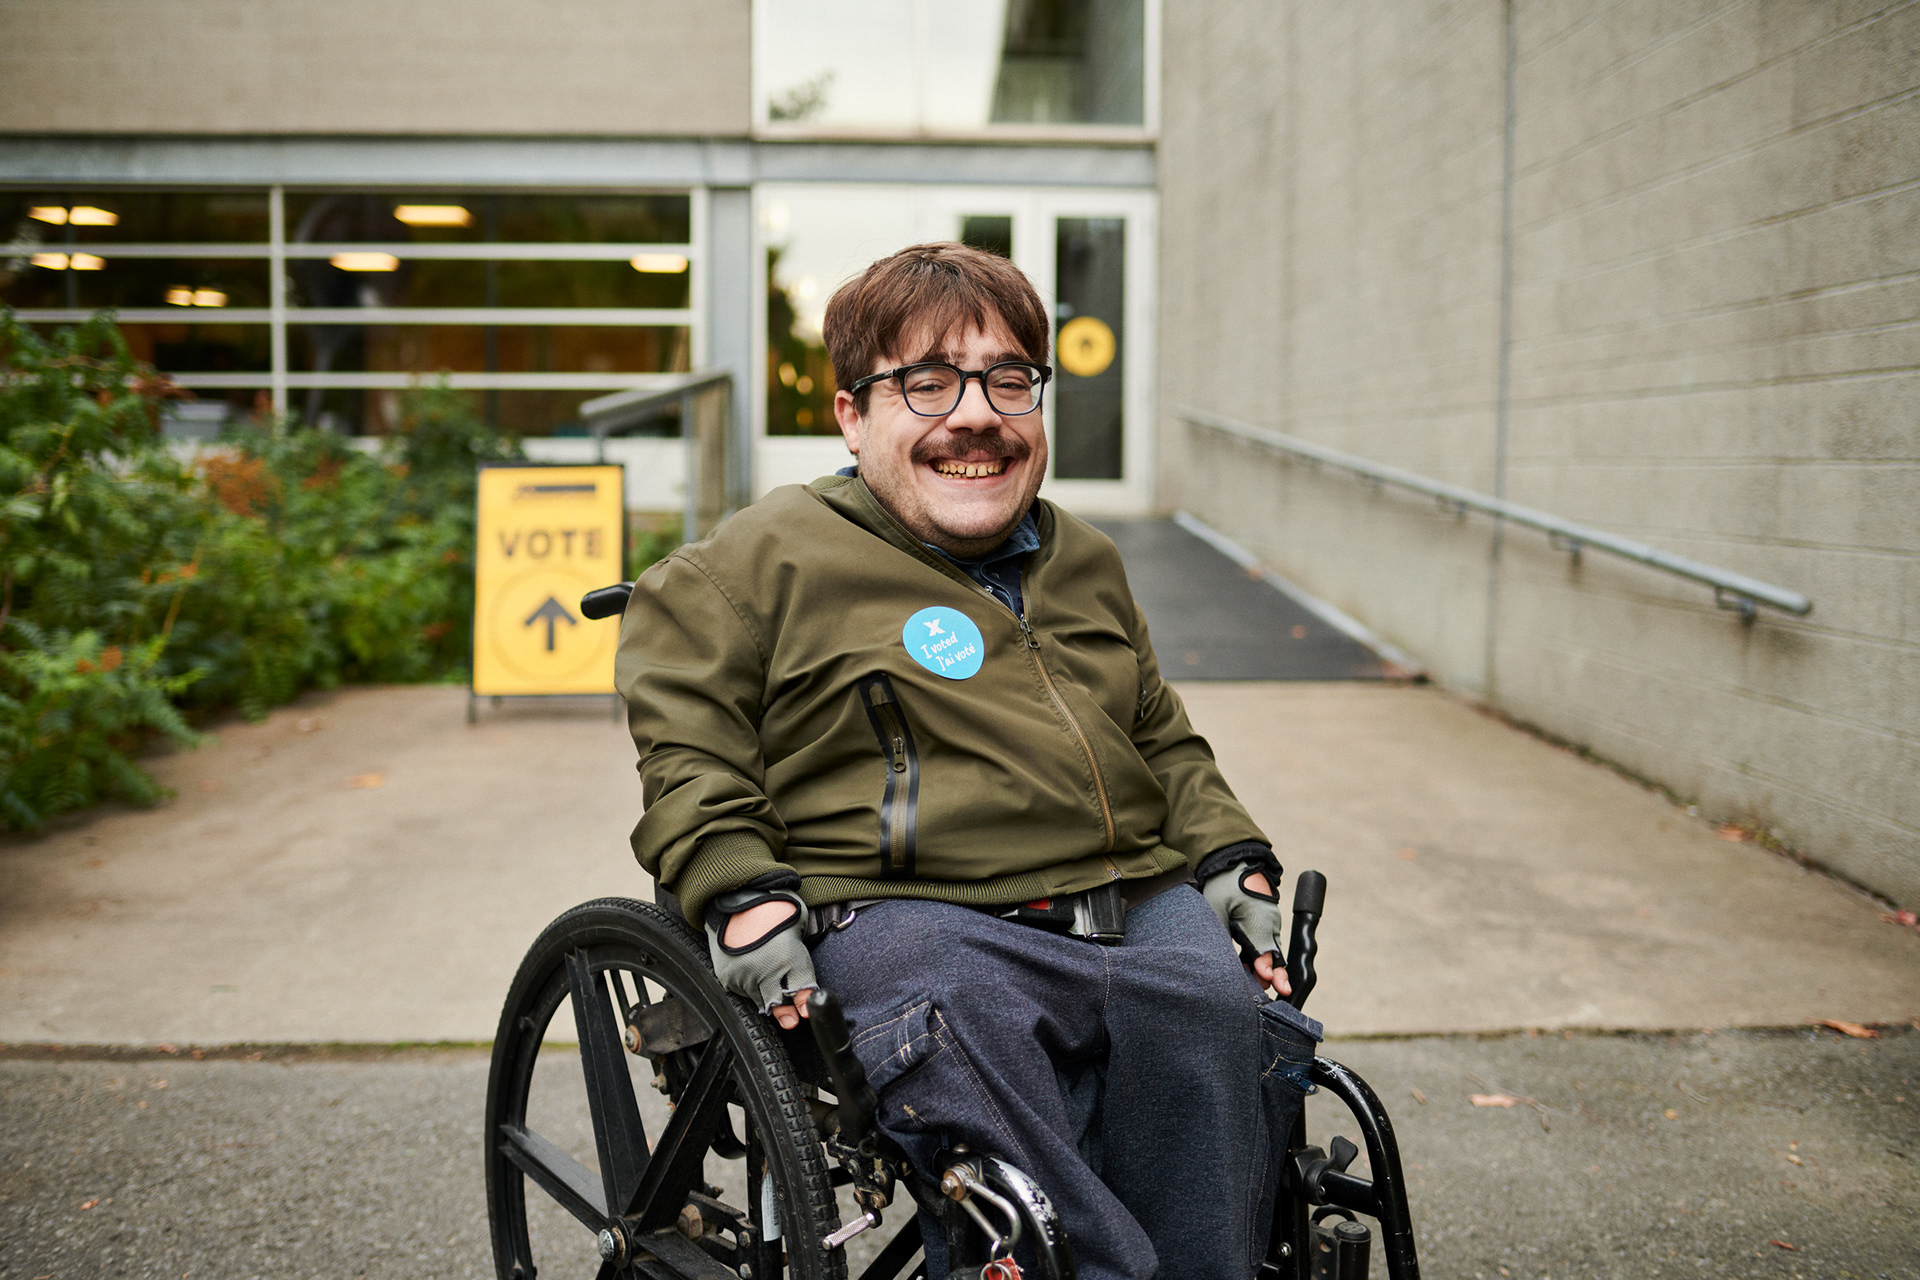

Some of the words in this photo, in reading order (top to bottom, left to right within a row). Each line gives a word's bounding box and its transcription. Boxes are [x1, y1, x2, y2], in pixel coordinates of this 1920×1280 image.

[498, 527, 604, 560] VOTE
[921, 644, 932, 659] I
[931, 631, 958, 654] voted
[936, 653, 955, 671] J'ai
[954, 643, 976, 662] voté
